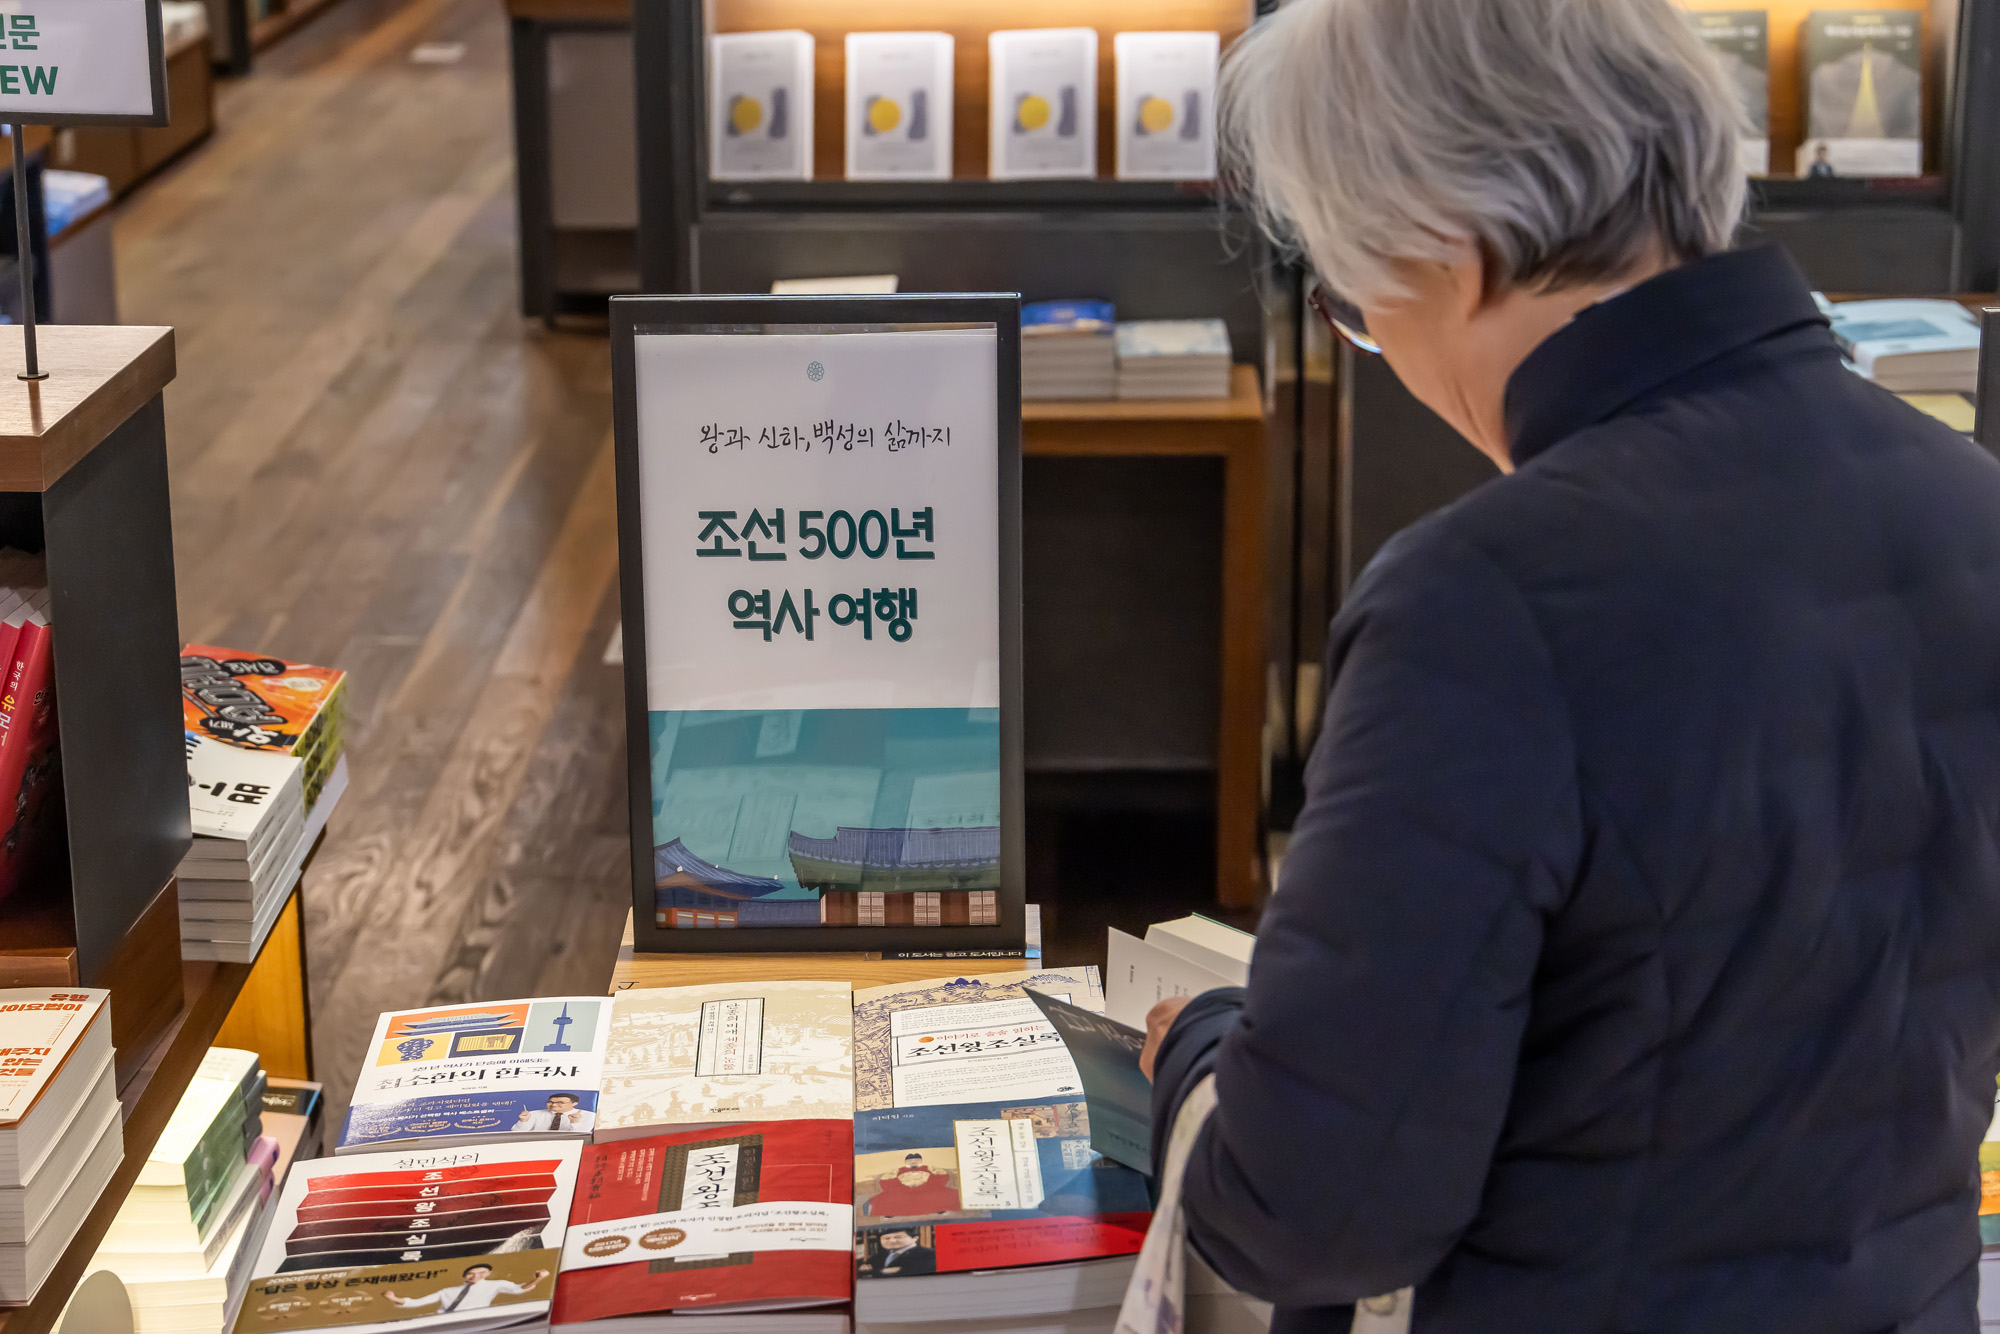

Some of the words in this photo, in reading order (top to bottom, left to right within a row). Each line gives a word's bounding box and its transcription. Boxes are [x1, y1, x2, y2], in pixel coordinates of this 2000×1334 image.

[700, 423, 750, 454] 왕과
[884, 419, 951, 453] 삶까지
[696, 507, 787, 561] 조선
[798, 506, 935, 560] 500년
[727, 588, 820, 642] 역사
[828, 587, 918, 642] 여행
[374, 1069, 487, 1091] 최소한의
[495, 1066, 581, 1080] 한국사
[393, 1153, 481, 1169] 설민석의
[304, 1279, 341, 1290] 항상
